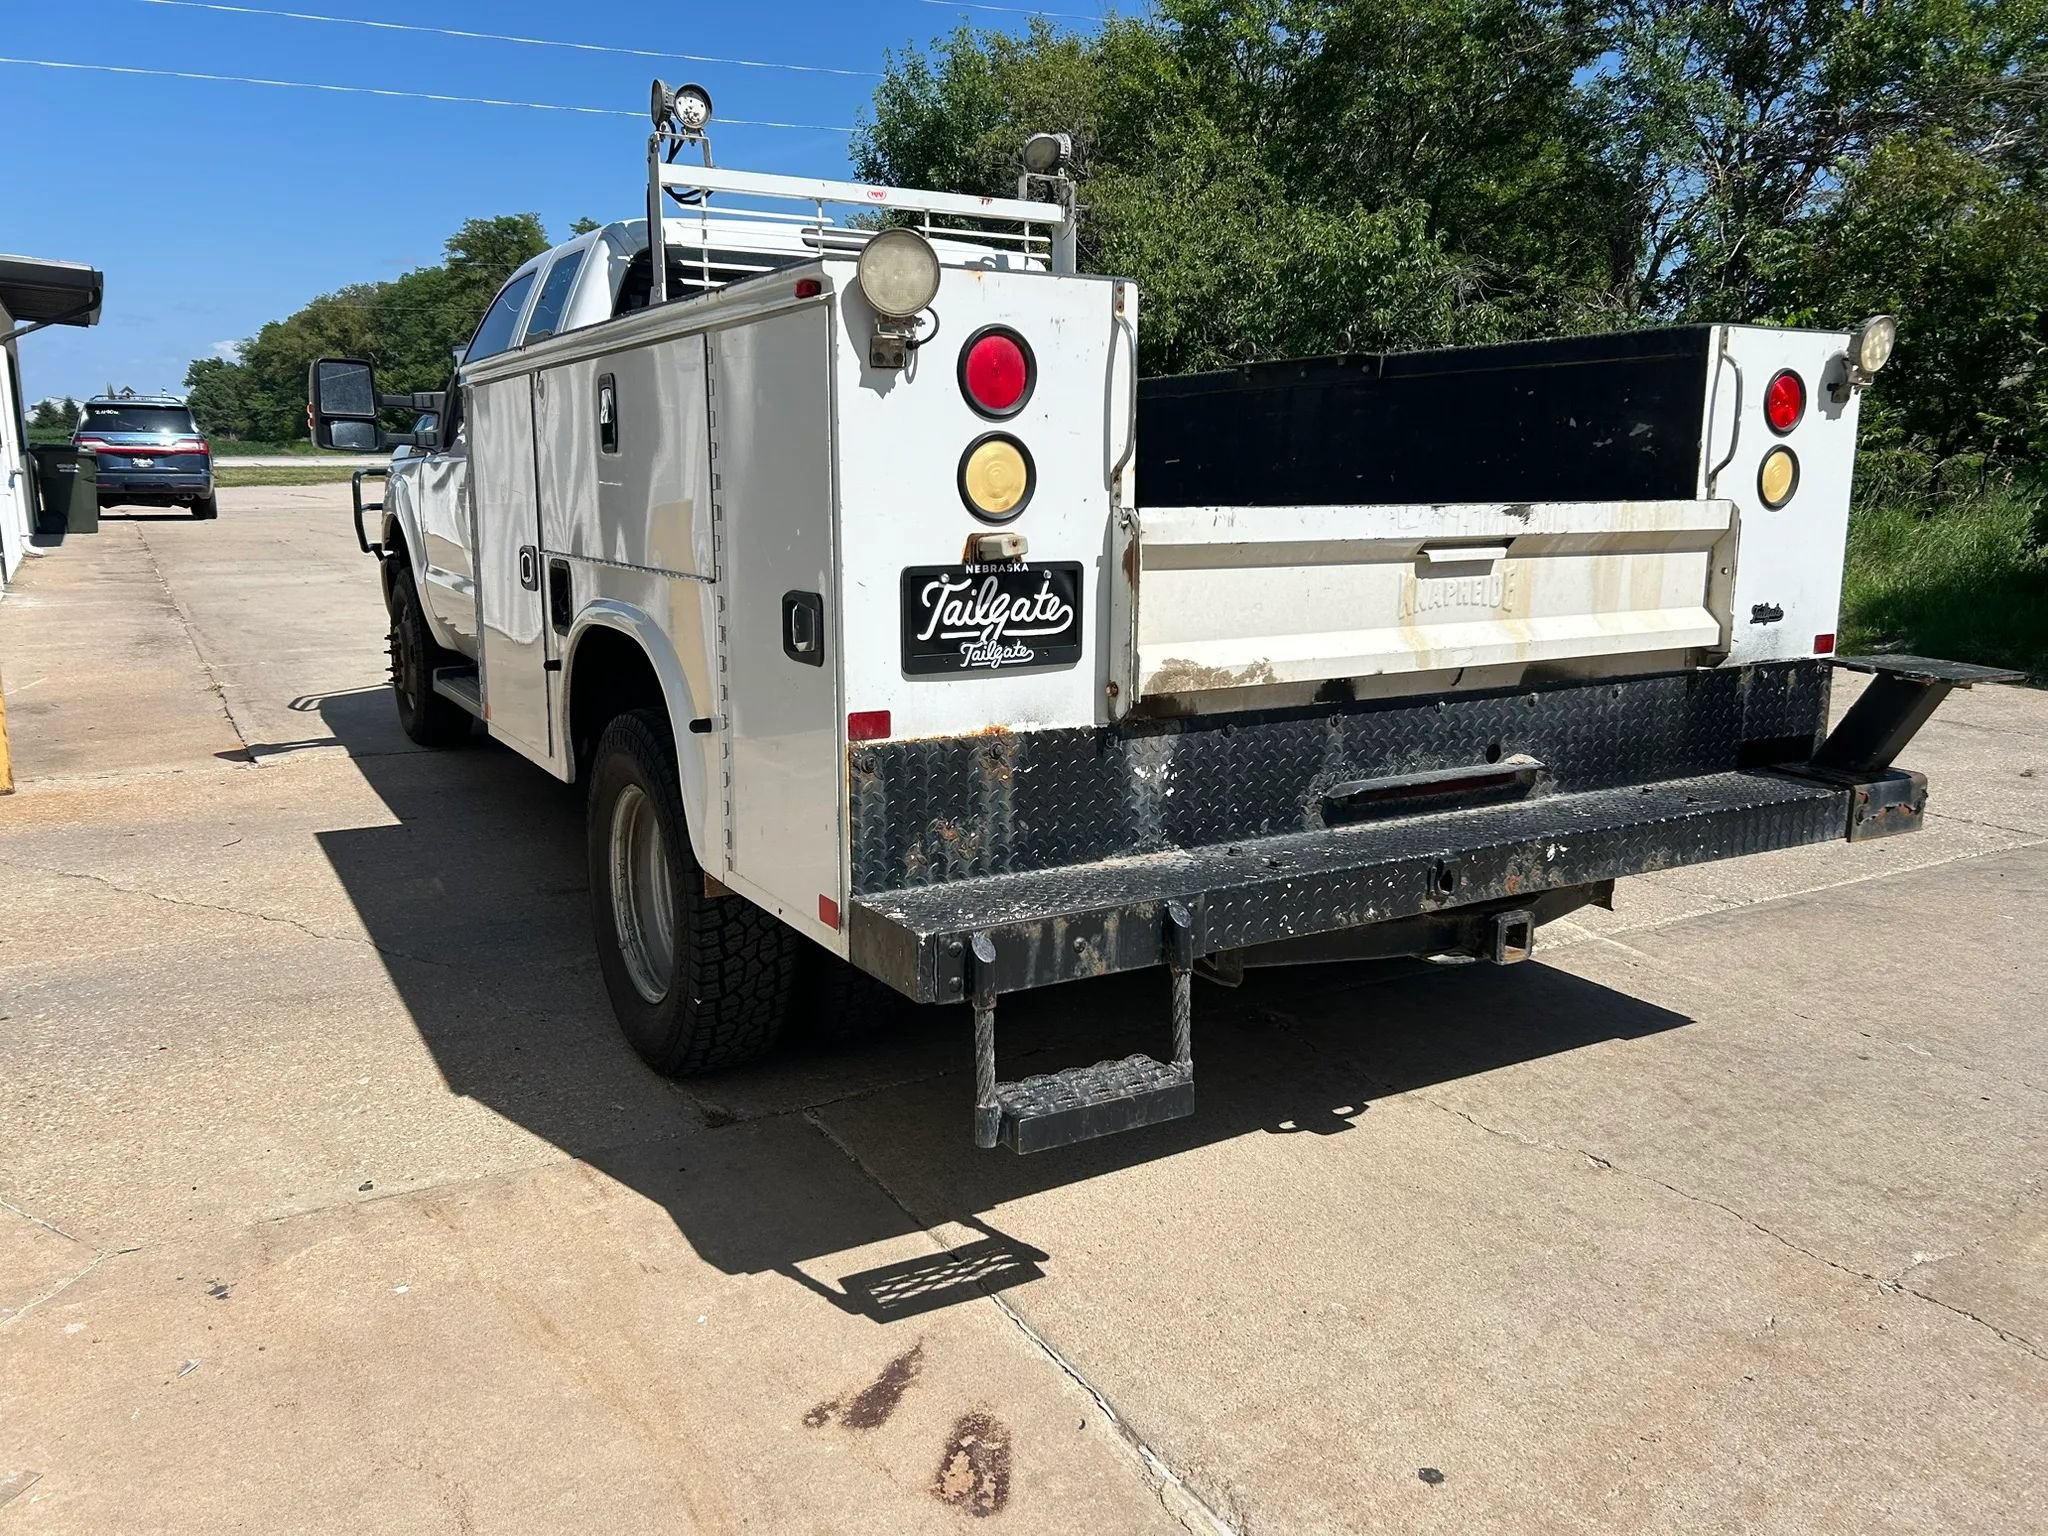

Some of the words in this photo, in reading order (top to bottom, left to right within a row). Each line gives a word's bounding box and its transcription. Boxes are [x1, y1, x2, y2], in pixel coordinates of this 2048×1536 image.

[966, 562, 1029, 574] NEBRASKA
[917, 576, 1074, 641] Tailgate
[1398, 567, 1516, 619] KNAPHEIDE
[960, 640, 1034, 668] Tailgate
